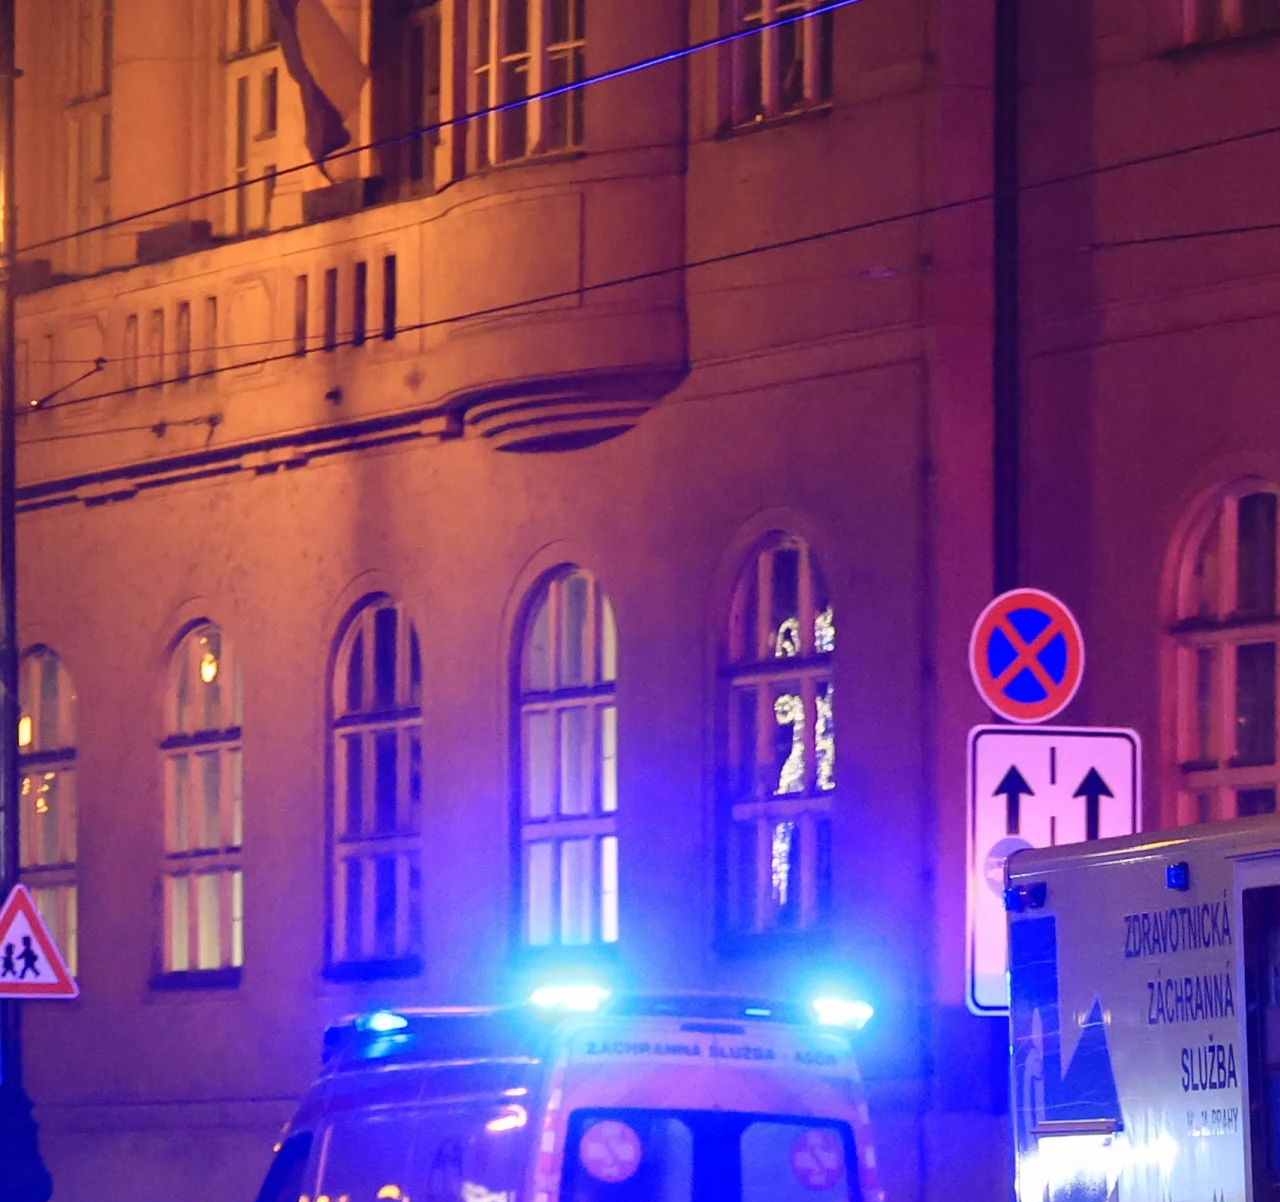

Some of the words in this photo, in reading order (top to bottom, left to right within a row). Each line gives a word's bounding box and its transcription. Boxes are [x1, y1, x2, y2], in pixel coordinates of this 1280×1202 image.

[1123, 888, 1233, 958] ZDRAVOTNICKÁ
[1147, 960, 1235, 1025] ZÁCHRANNÁ
[1181, 1033, 1238, 1092] SLUŽBA
